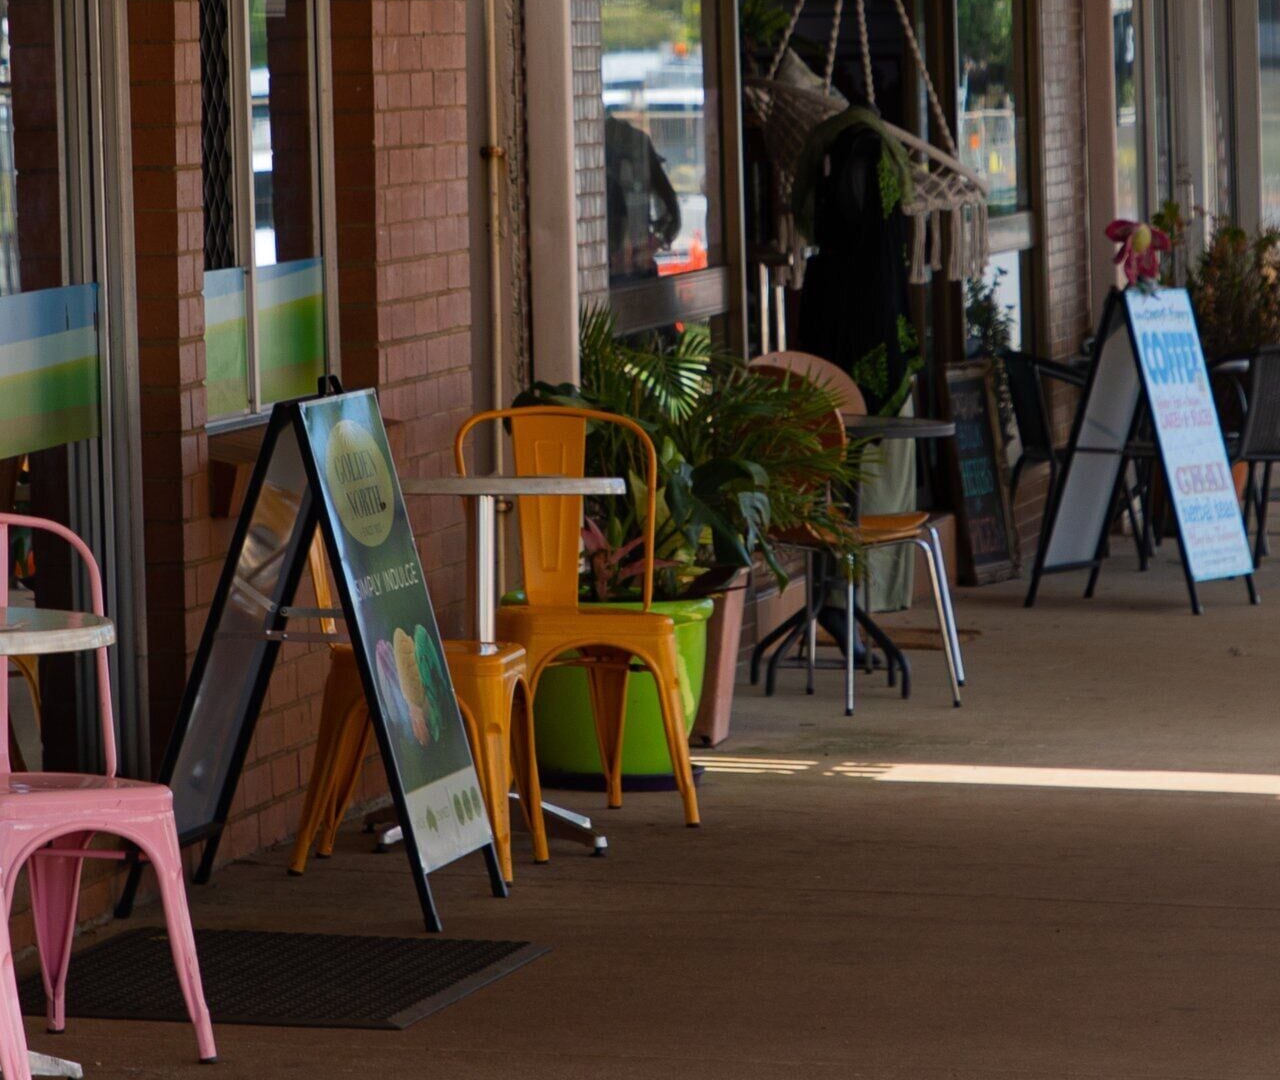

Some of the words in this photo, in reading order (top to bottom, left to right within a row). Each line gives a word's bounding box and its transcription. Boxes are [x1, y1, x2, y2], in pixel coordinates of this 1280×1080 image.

[333, 450, 377, 485] GOLDEN
[346, 485, 382, 520] NORTH
[382, 562, 418, 592] INDULGE
